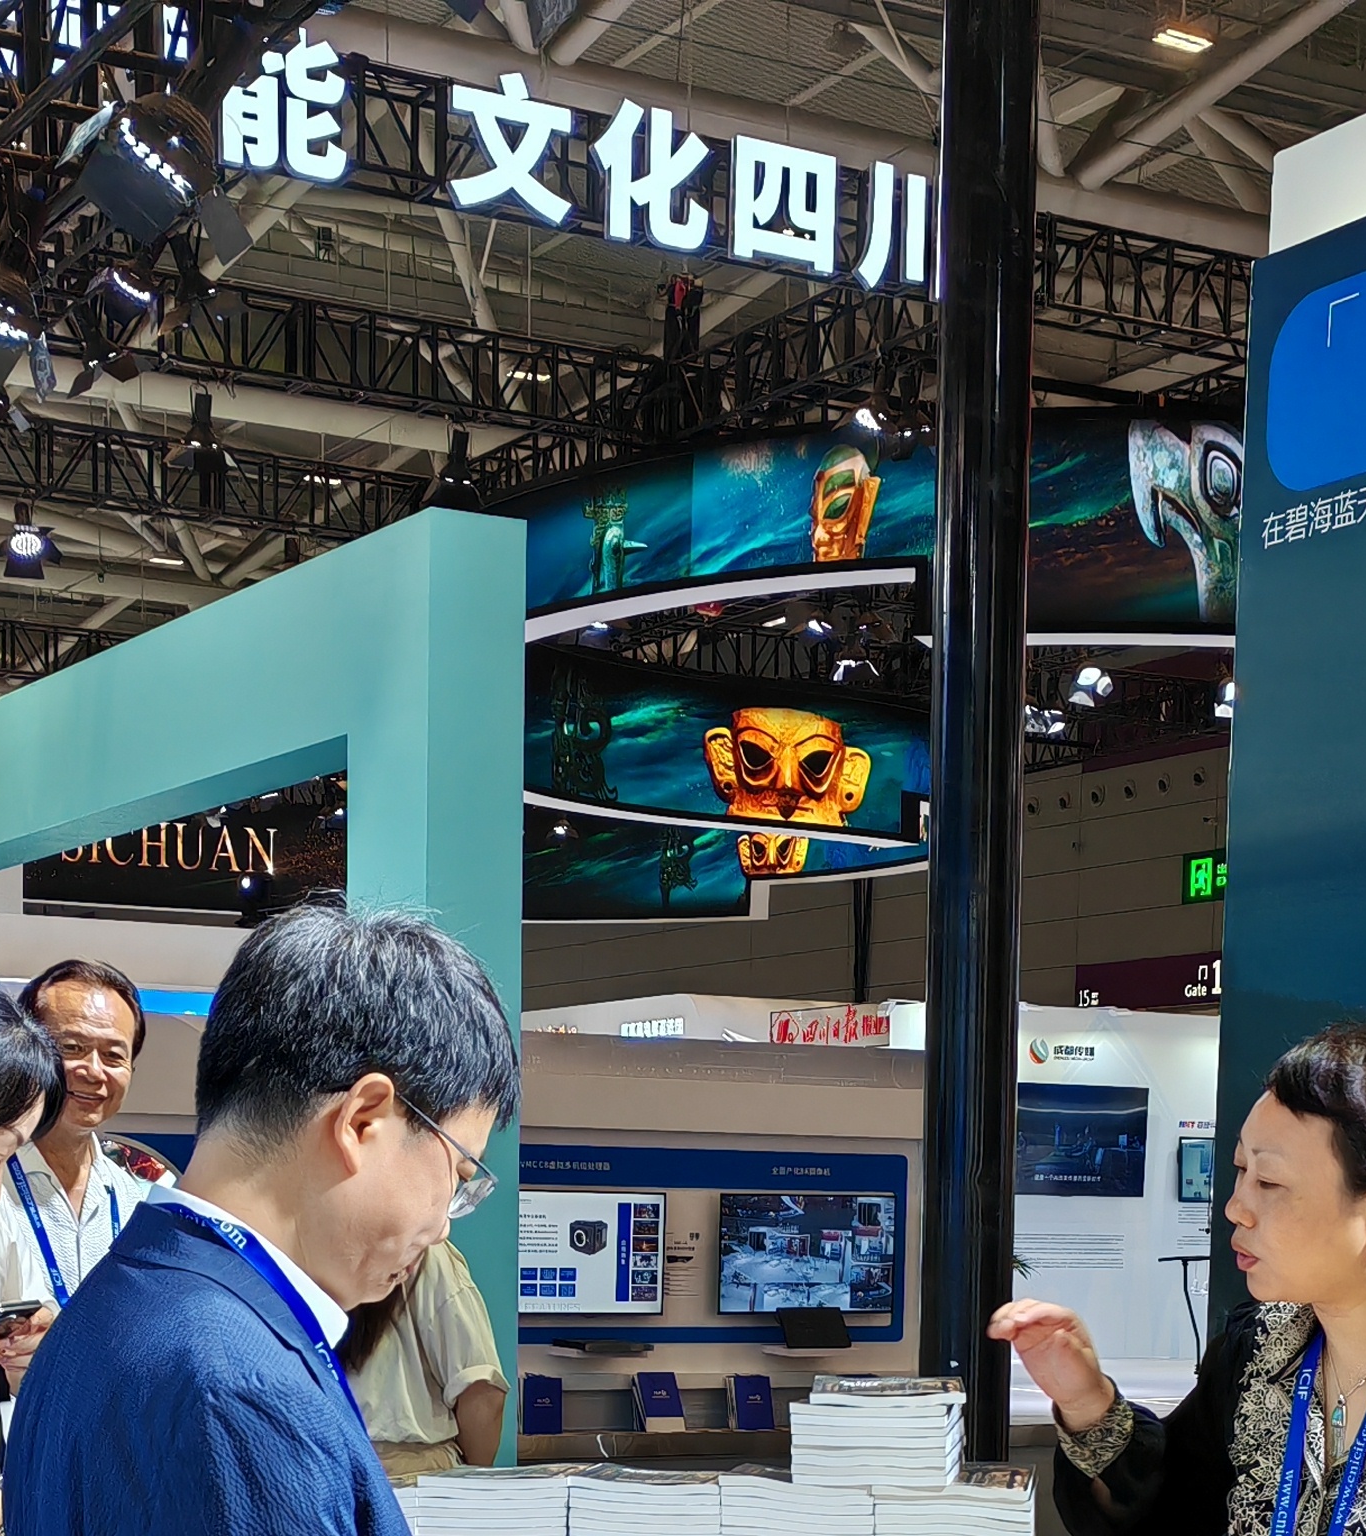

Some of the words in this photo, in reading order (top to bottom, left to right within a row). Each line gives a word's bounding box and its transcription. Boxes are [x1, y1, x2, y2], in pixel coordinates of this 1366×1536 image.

[448, 72, 926, 289] 文化四川
[1185, 984, 1207, 998] Gate
[1297, 1368, 1312, 1401] ICIF
